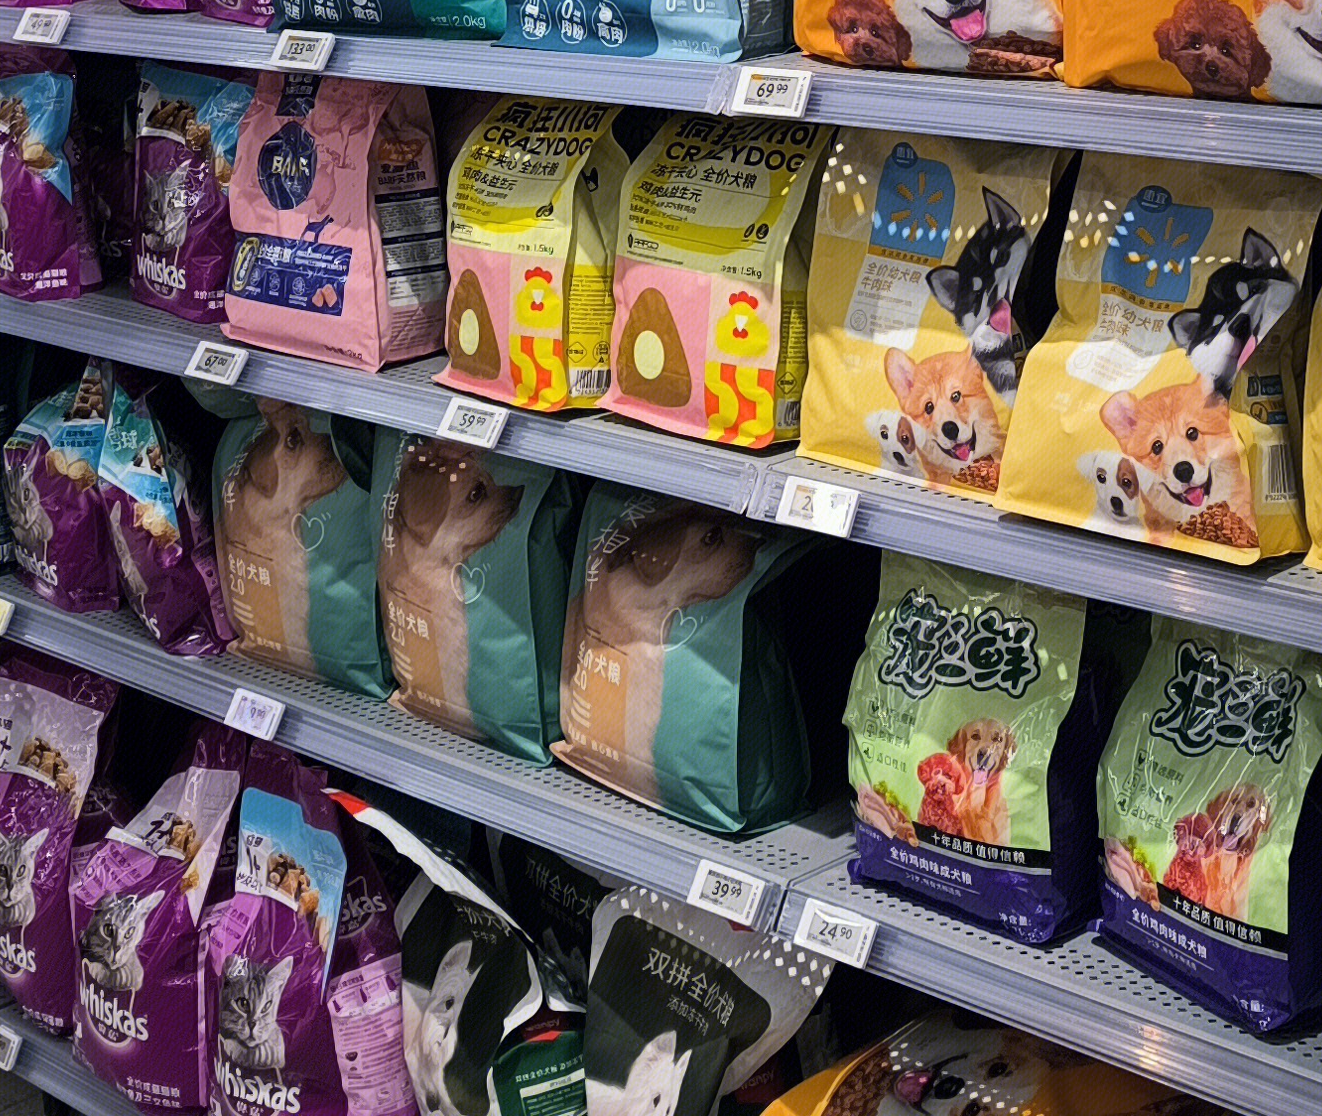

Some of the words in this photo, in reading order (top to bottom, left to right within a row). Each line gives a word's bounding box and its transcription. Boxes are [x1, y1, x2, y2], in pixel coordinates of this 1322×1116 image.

[483, 126, 595, 157] CRAZYDOG
[519, 159, 559, 176] 全价犬粮
[699, 165, 758, 190] 全价犬粮
[136, 254, 187, 291] whiskas
[864, 260, 921, 286] 全价幼犬粮
[931, 832, 974, 857] 十年品质
[975, 841, 1027, 865] 值得信赖
[1173, 896, 1210, 926] 十年品质
[641, 947, 736, 1029] 双拼全价犬粮
[79, 987, 149, 1041] whiskas
[213, 1056, 302, 1115] whiskas
